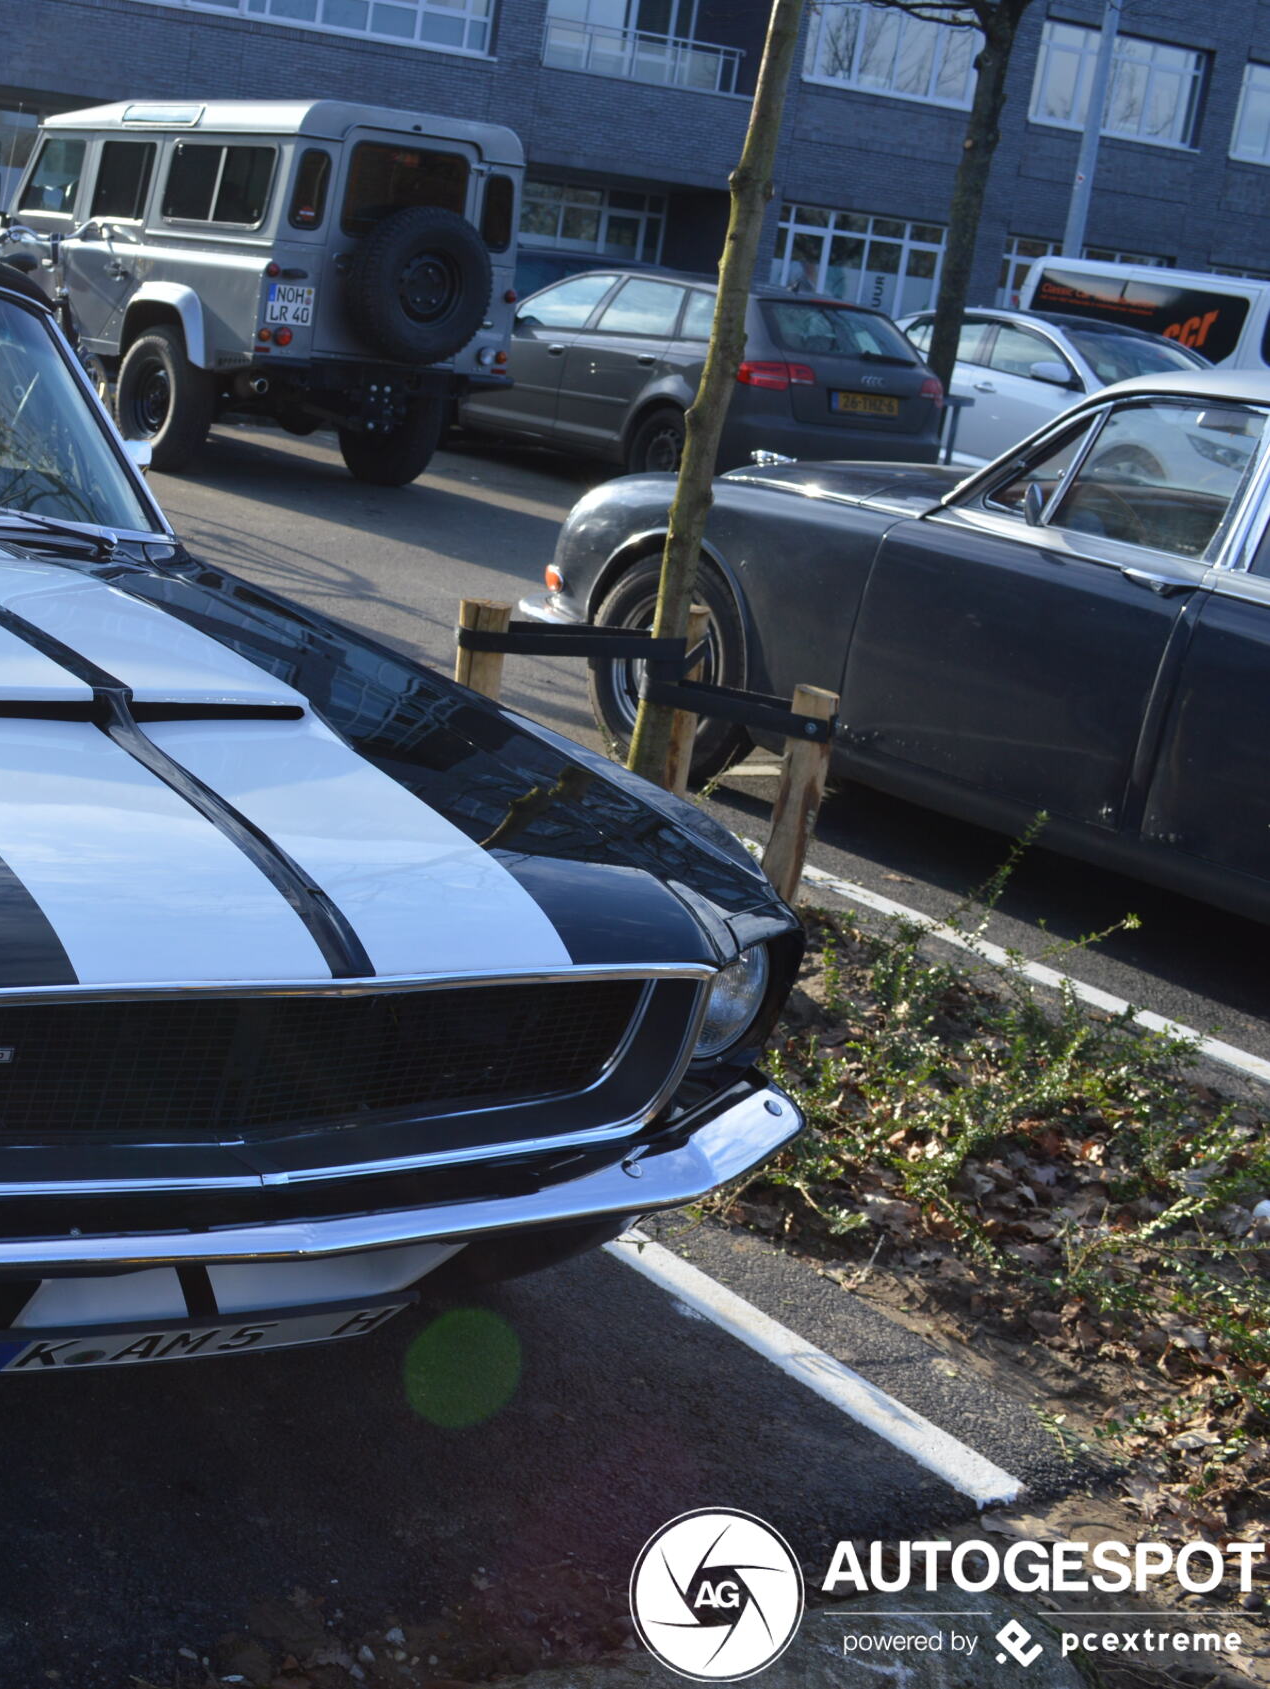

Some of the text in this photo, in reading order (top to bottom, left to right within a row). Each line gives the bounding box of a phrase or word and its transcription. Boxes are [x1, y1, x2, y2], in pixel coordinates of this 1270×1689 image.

[276, 287, 305, 305] NOH
[270, 305, 310, 323] LR 40
[14, 1305, 399, 1368] K AM 5 H
